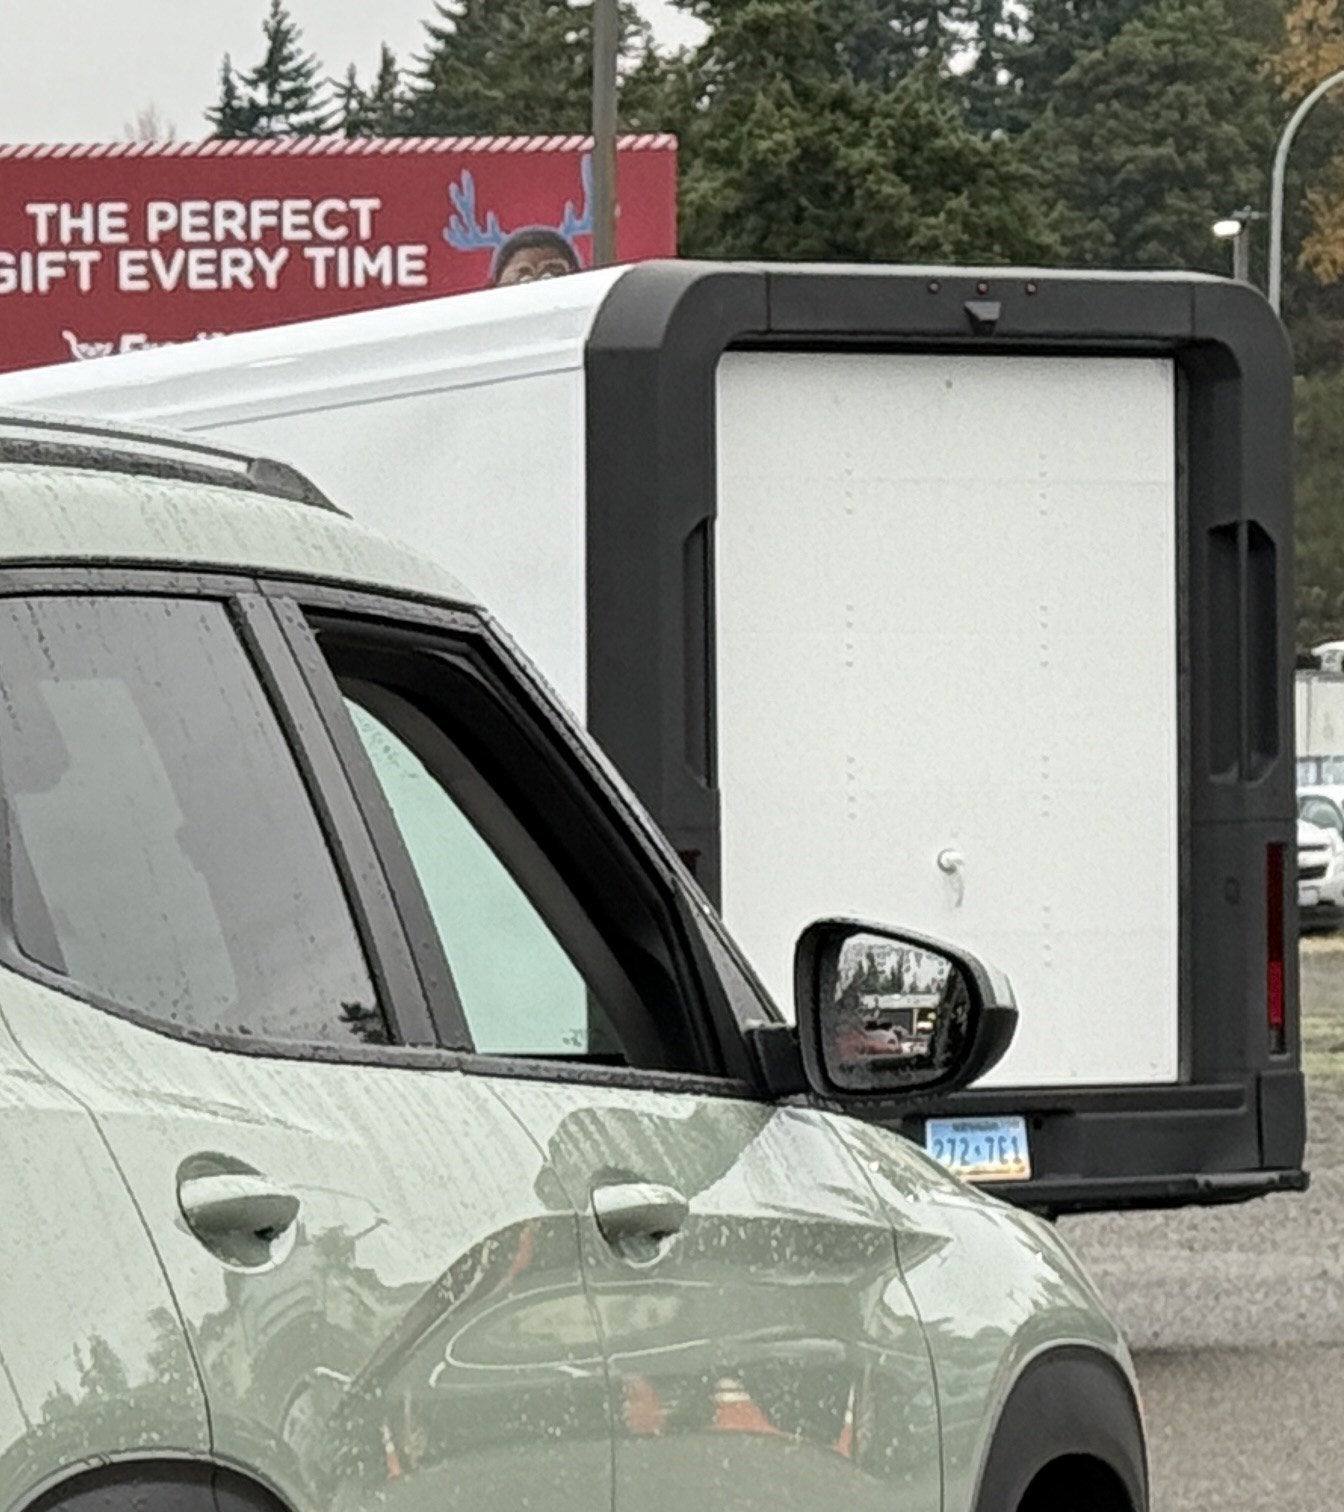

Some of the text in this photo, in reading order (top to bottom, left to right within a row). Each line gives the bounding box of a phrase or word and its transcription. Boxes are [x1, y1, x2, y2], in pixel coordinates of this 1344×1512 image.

[25, 198, 382, 245] THE PERFECT
[118, 247, 289, 292] EVERY
[303, 244, 429, 288] TIME
